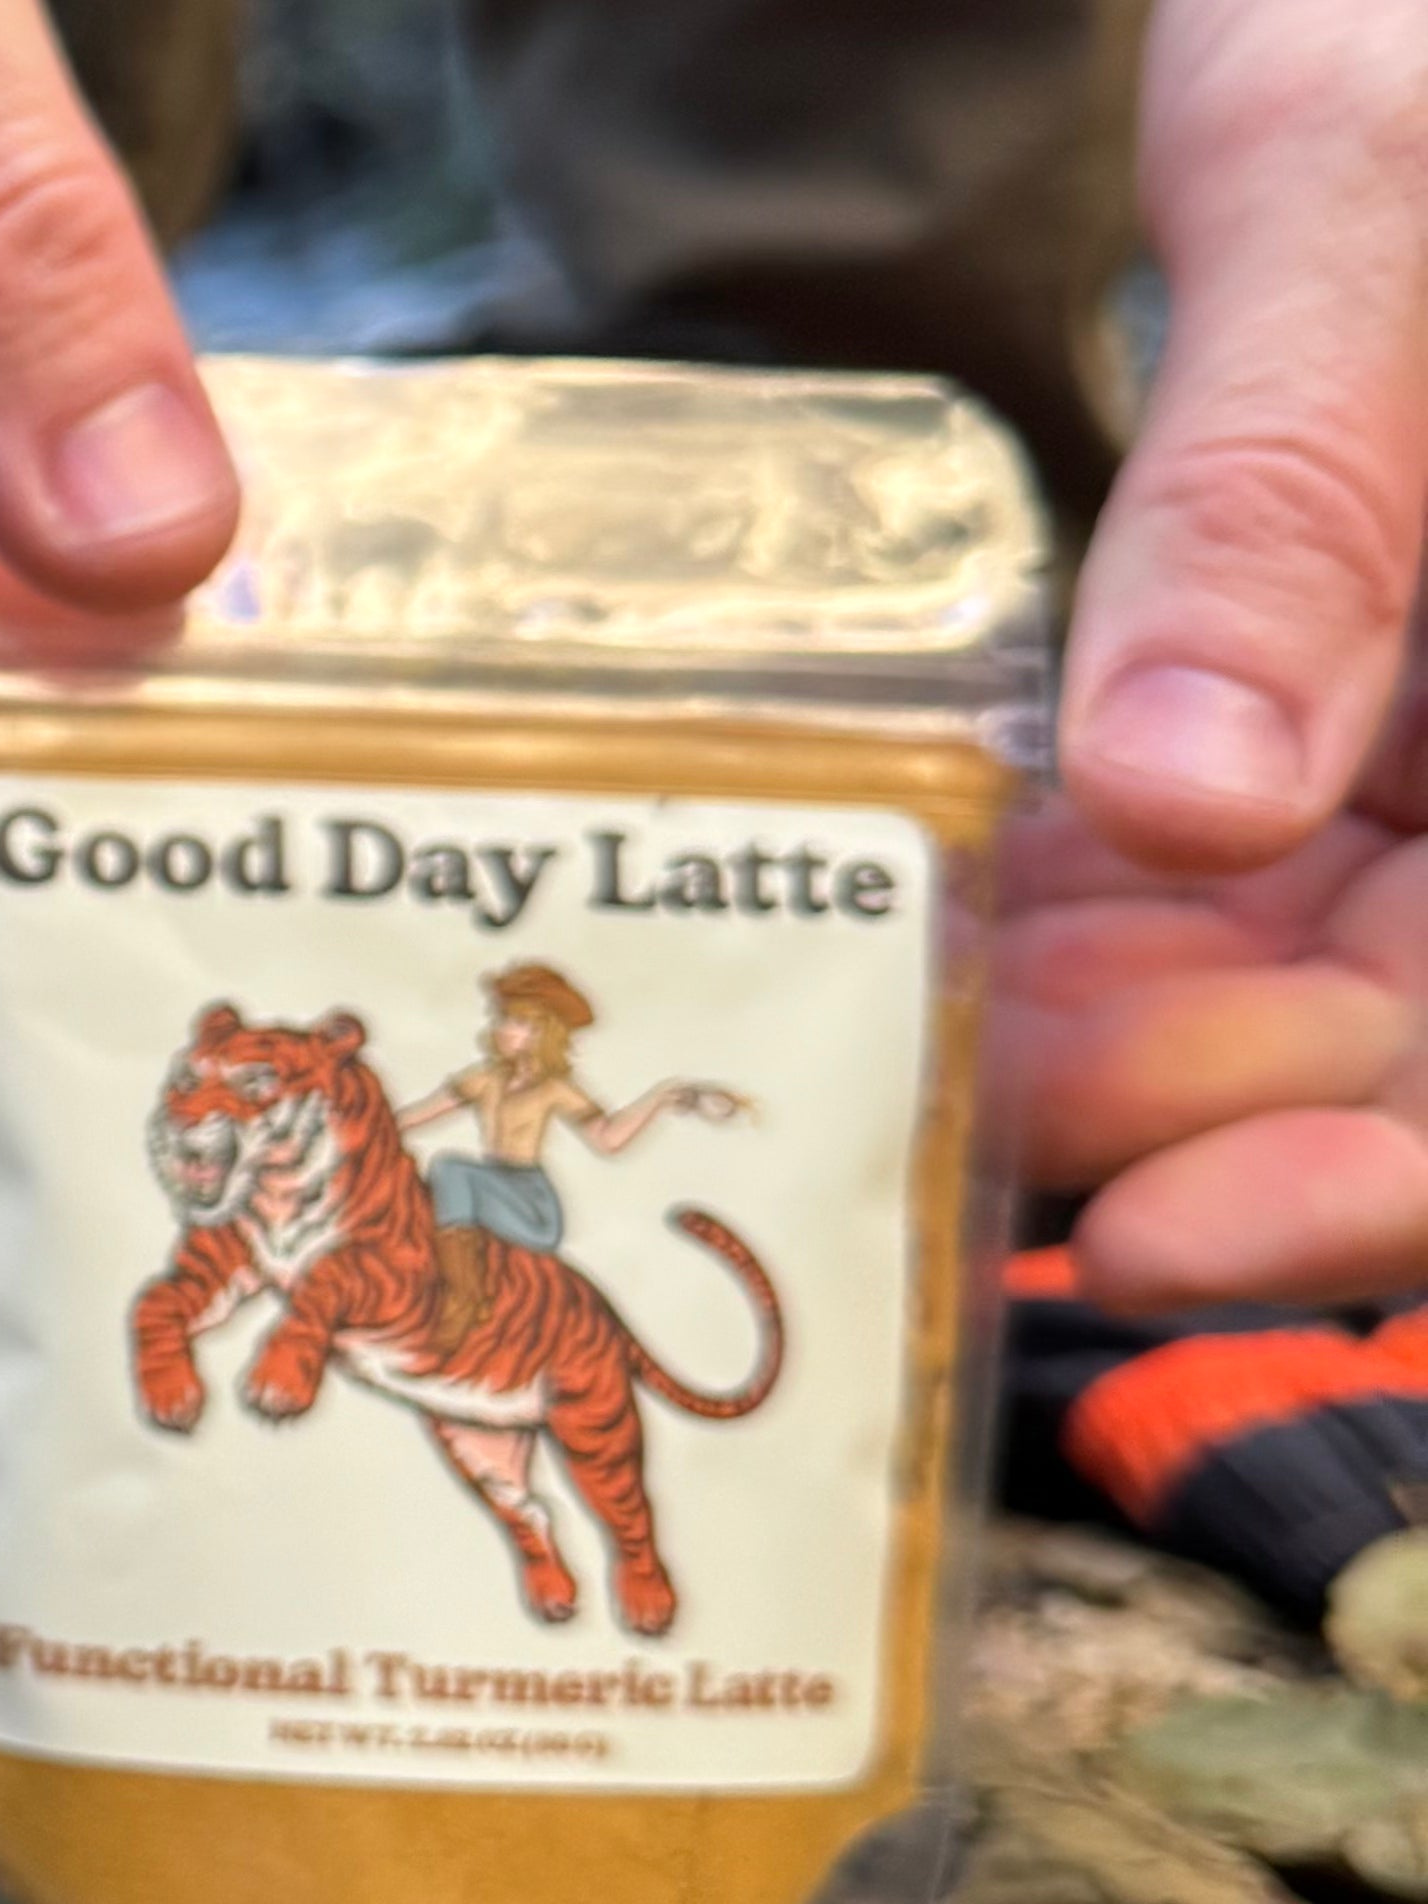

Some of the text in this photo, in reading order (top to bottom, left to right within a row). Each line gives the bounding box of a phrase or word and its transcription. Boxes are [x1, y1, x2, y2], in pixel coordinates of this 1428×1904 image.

[323, 819, 557, 933] Day
[589, 831, 896, 921] Latte
[366, 1651, 674, 1709] Turmeric
[685, 1660, 838, 1713] Latte
